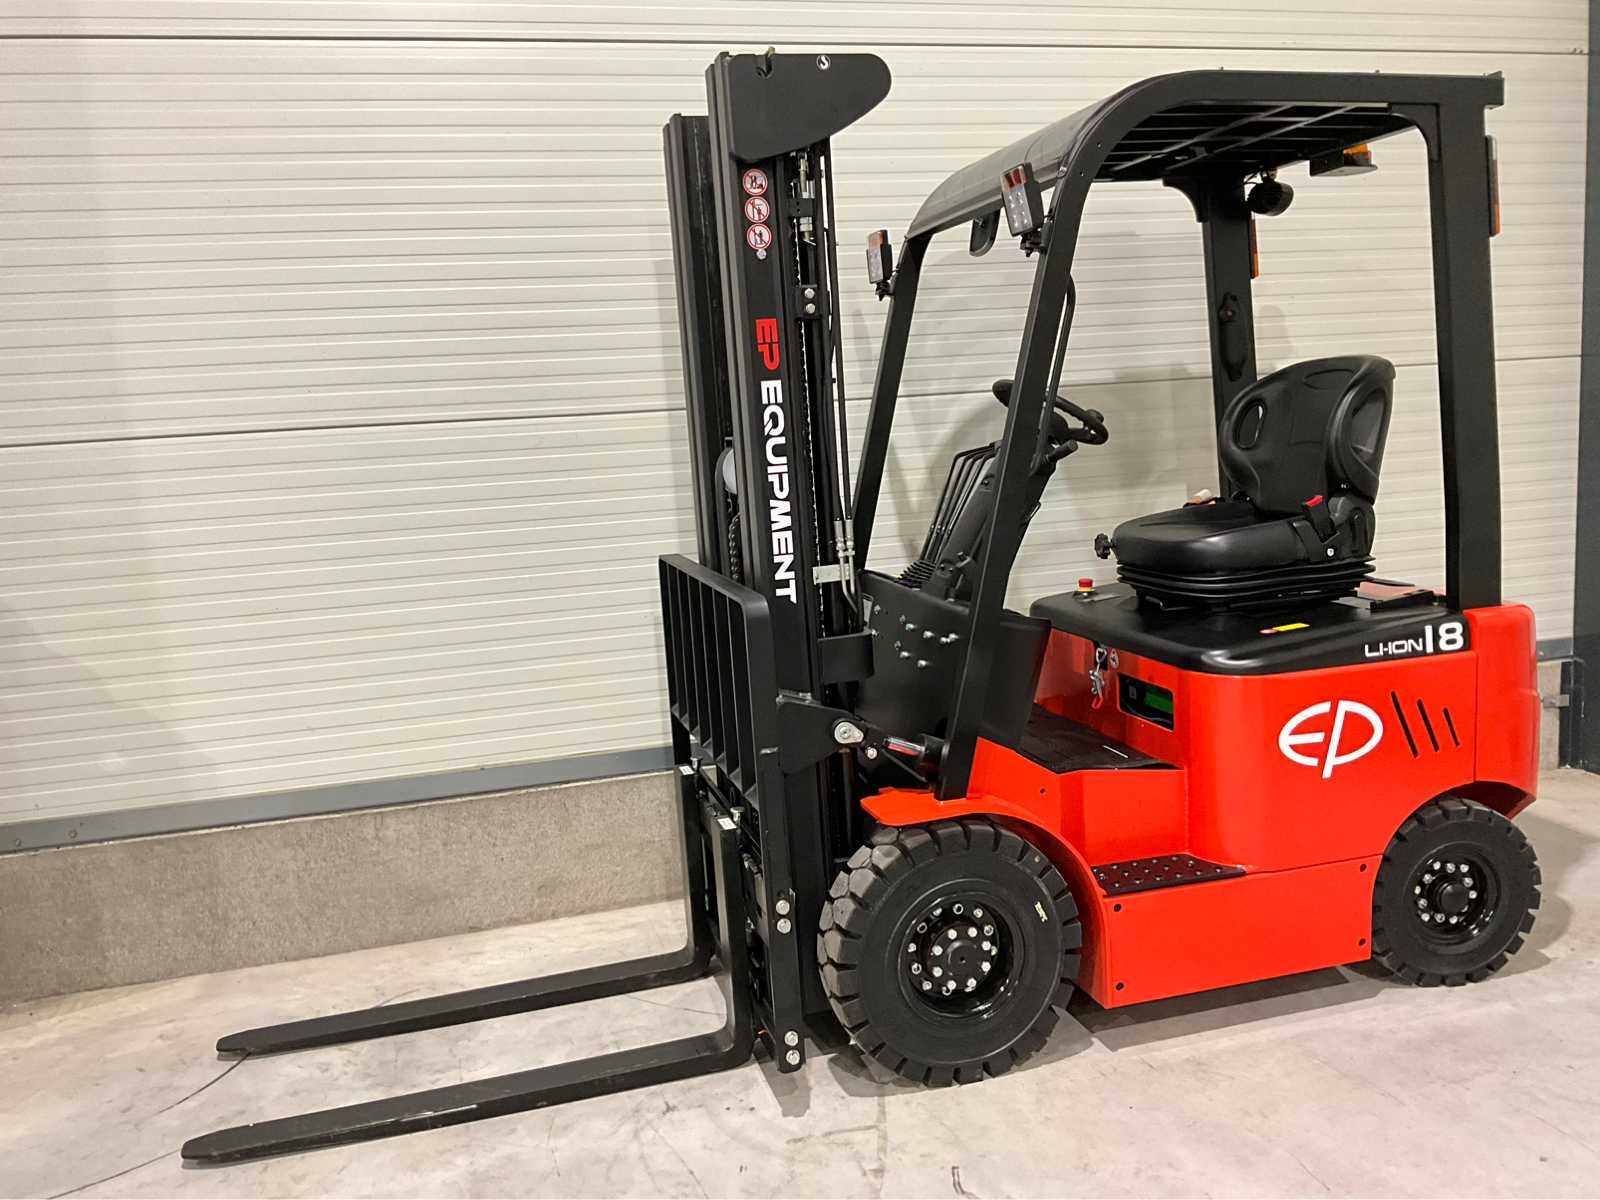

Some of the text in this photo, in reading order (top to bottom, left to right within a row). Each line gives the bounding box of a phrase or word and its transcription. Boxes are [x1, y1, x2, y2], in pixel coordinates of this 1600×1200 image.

[756, 318, 797, 604] EP EQUIPMENT
[1424, 622, 1464, 653] 18
[1278, 699, 1384, 779] EP
